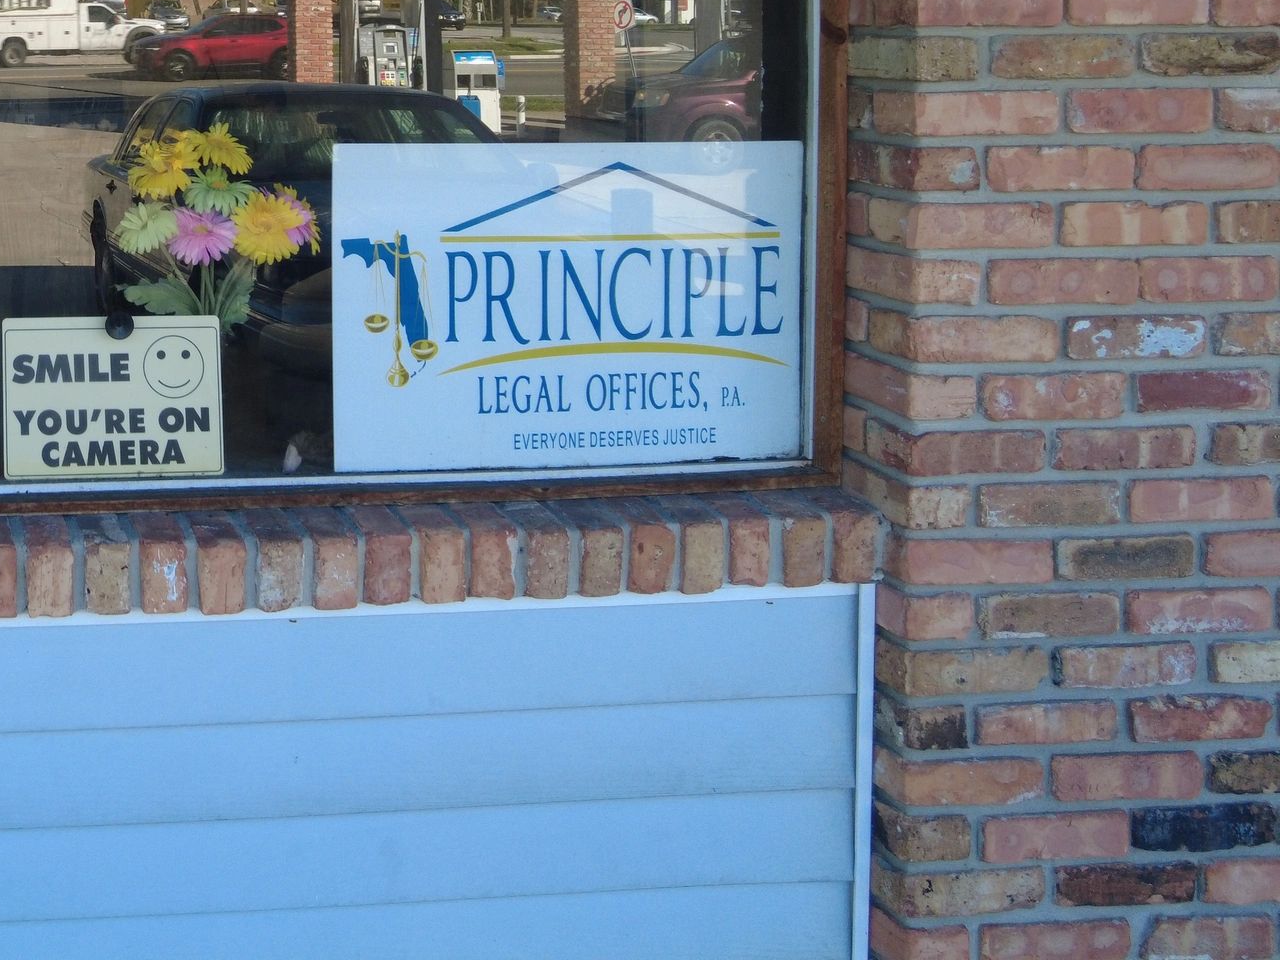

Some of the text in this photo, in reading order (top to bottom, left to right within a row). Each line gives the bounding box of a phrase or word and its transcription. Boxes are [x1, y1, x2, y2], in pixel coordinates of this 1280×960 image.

[445, 245, 784, 345] PRINCIPLE
[12, 353, 131, 385] SMILE
[477, 371, 745, 415] LEGAL OFFICES, P.A.
[13, 407, 210, 436] YOU'RE ON
[41, 439, 186, 468] CAMERA
[514, 427, 717, 451] EVERYONE DESERVES JUSTICE
